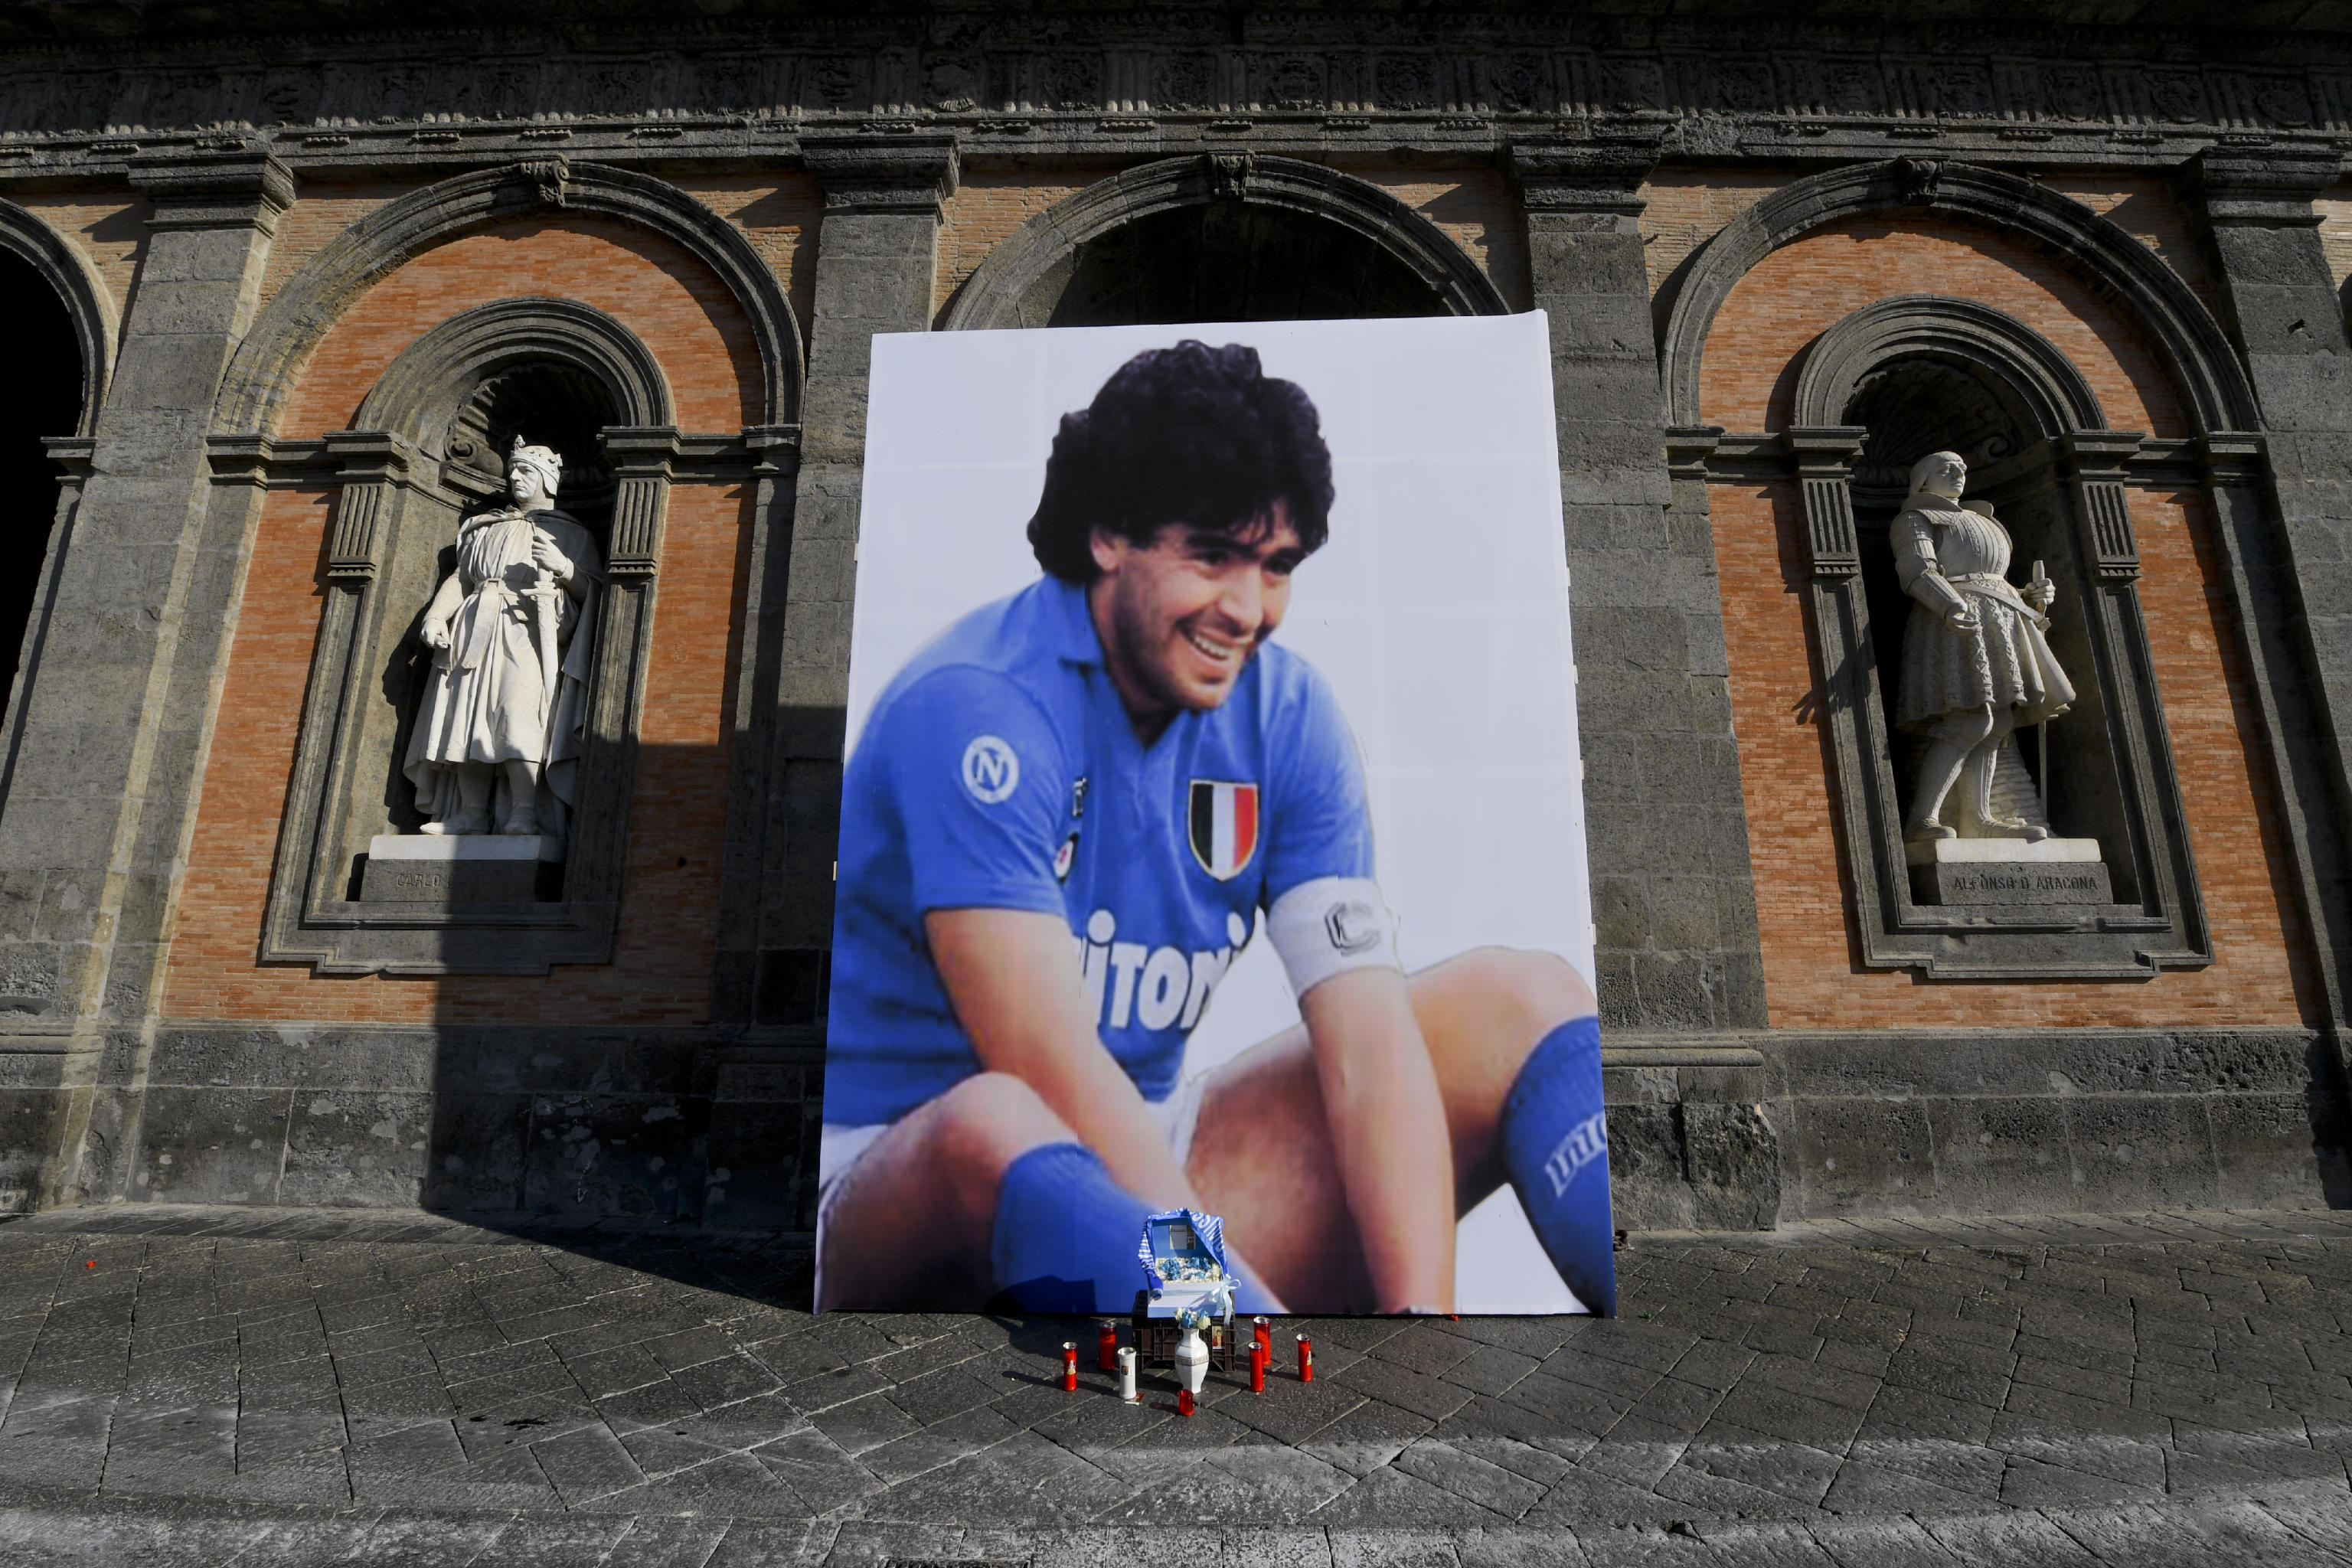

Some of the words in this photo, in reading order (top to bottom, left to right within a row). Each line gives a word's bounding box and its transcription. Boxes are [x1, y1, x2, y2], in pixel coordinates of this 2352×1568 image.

[975, 750, 1005, 788] N
[397, 874, 441, 887] CARLO
[1954, 876, 2015, 890] ALFONSO
[1325, 902, 1381, 957] C
